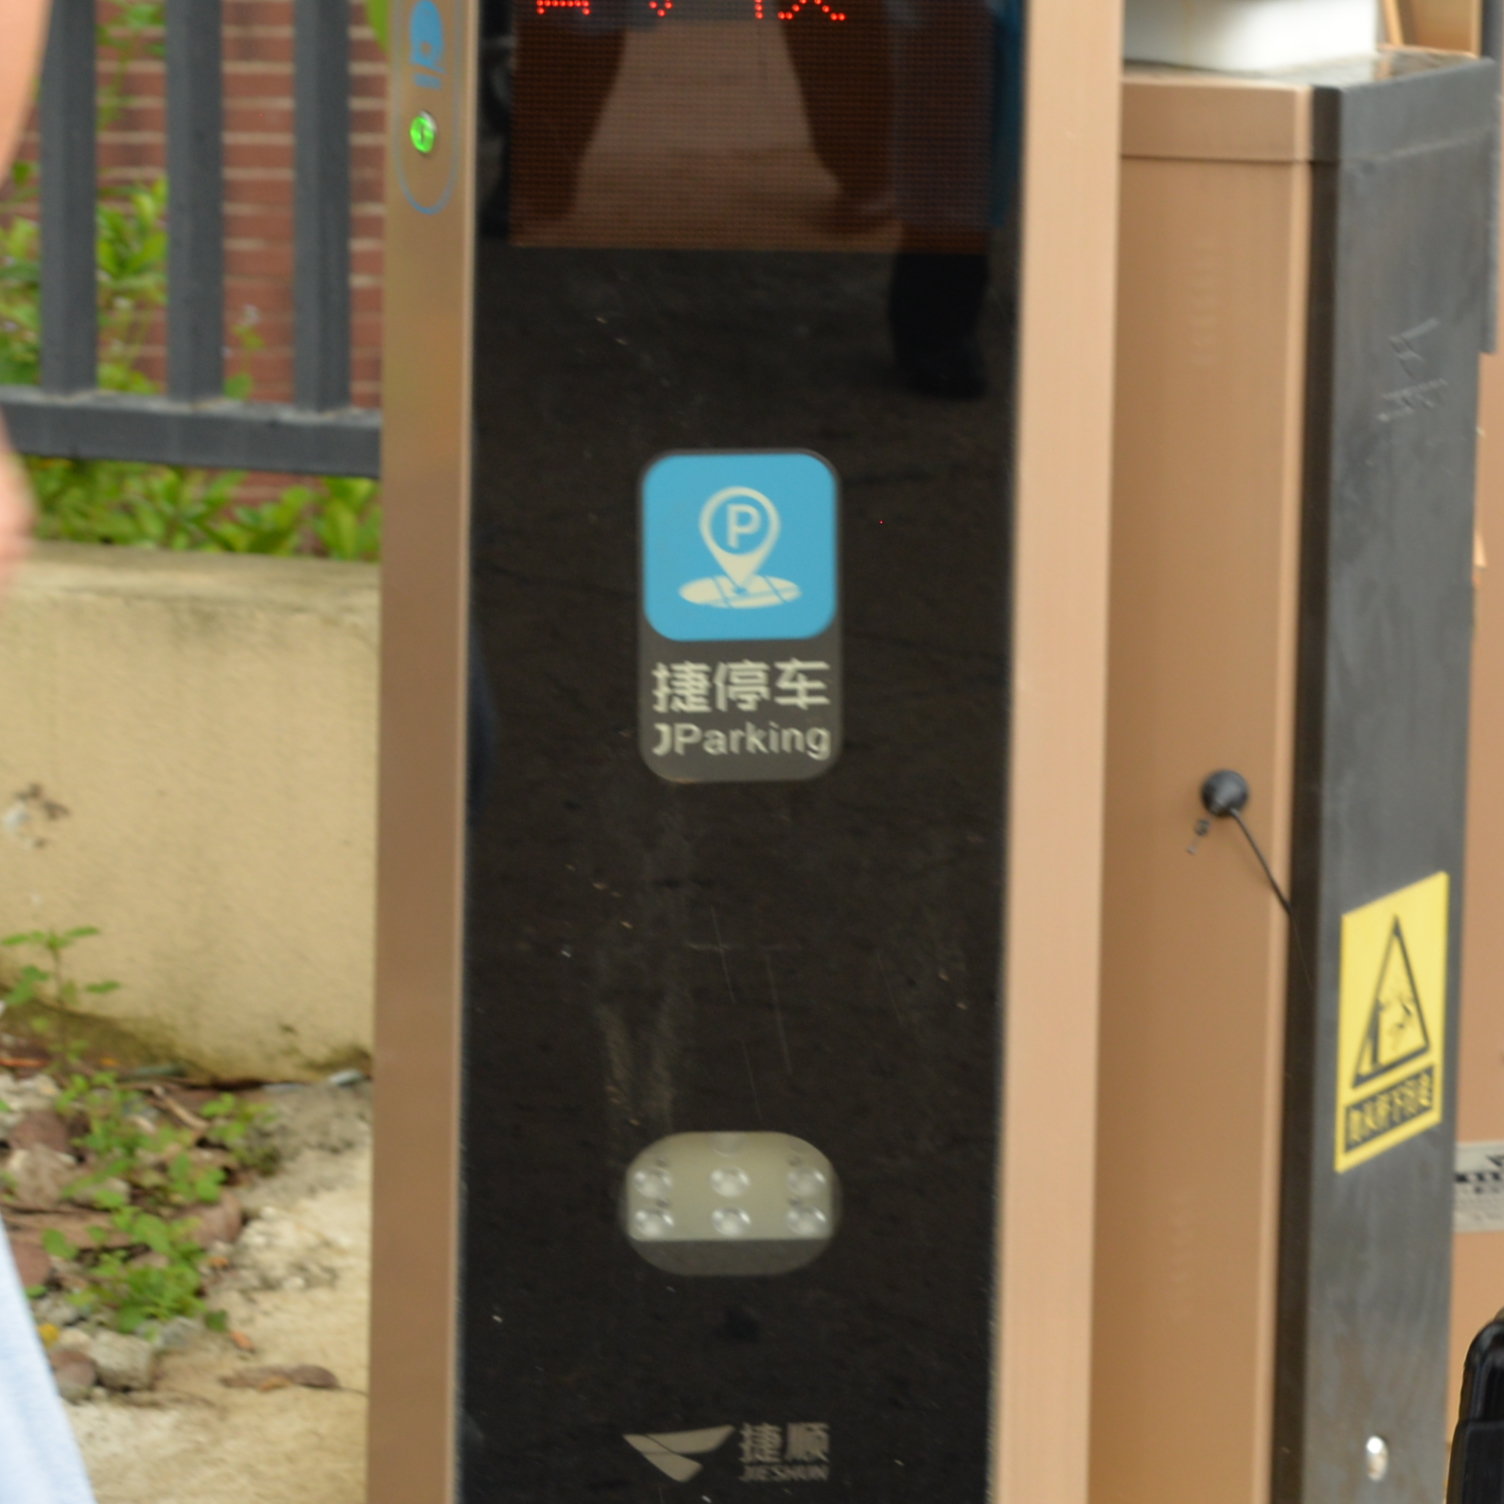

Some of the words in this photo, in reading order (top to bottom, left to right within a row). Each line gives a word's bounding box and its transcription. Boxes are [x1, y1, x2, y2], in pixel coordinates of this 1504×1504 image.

[726, 503, 761, 550] P
[651, 658, 831, 713] 捷停车
[652, 721, 831, 761] JParking
